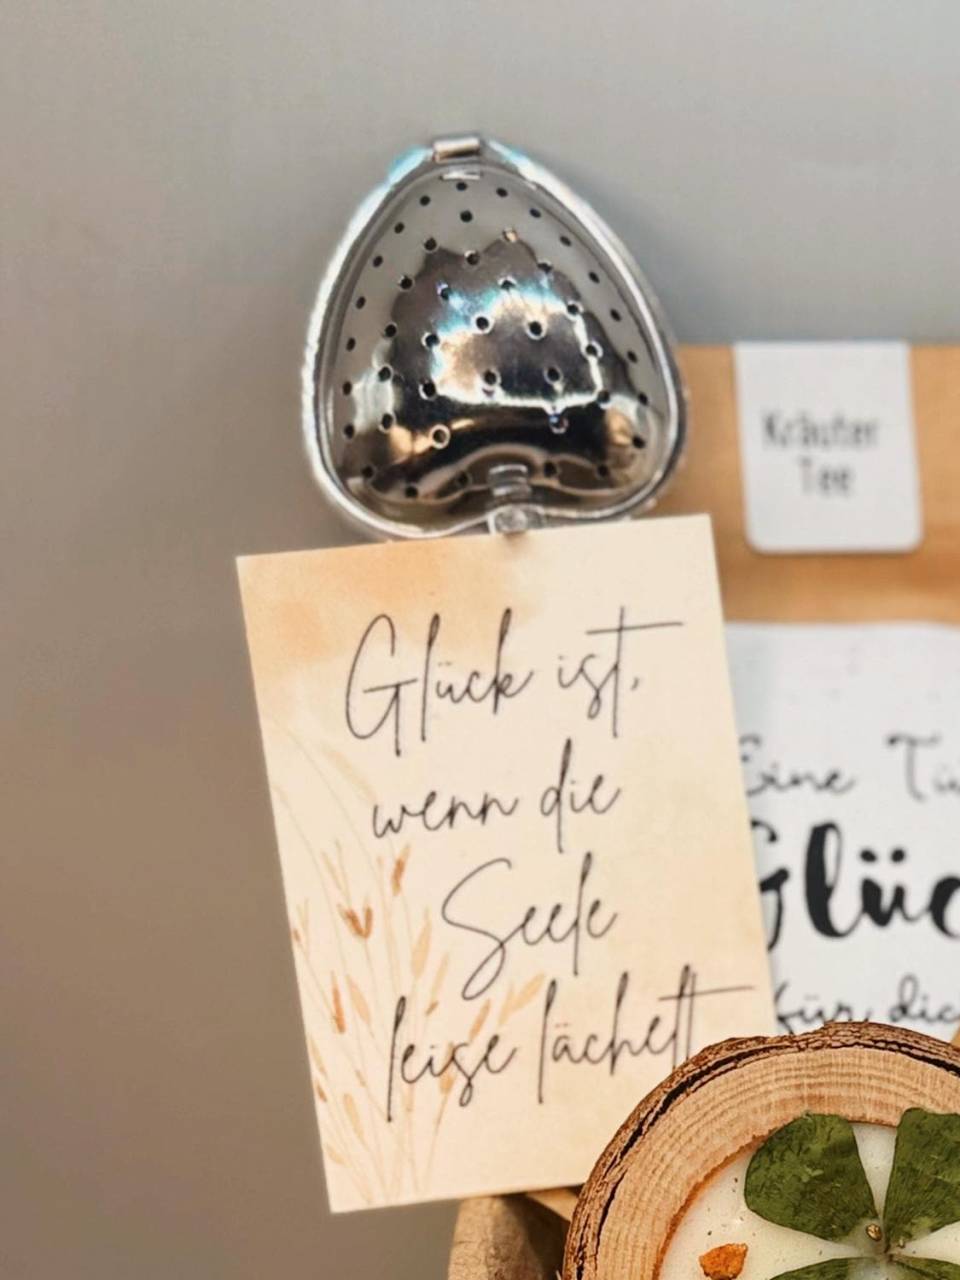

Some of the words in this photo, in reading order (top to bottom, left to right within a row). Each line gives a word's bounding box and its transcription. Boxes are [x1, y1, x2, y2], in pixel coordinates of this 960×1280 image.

[799, 456, 856, 496] Tee
[345, 607, 535, 757] Glück
[556, 605, 685, 738] ist,
[372, 792, 519, 840] wenn
[540, 737, 622, 855] die
[738, 733, 857, 797] Eine
[441, 851, 620, 1001] Seele
[386, 996, 517, 1124] leise
[537, 963, 756, 1105] lächelt
